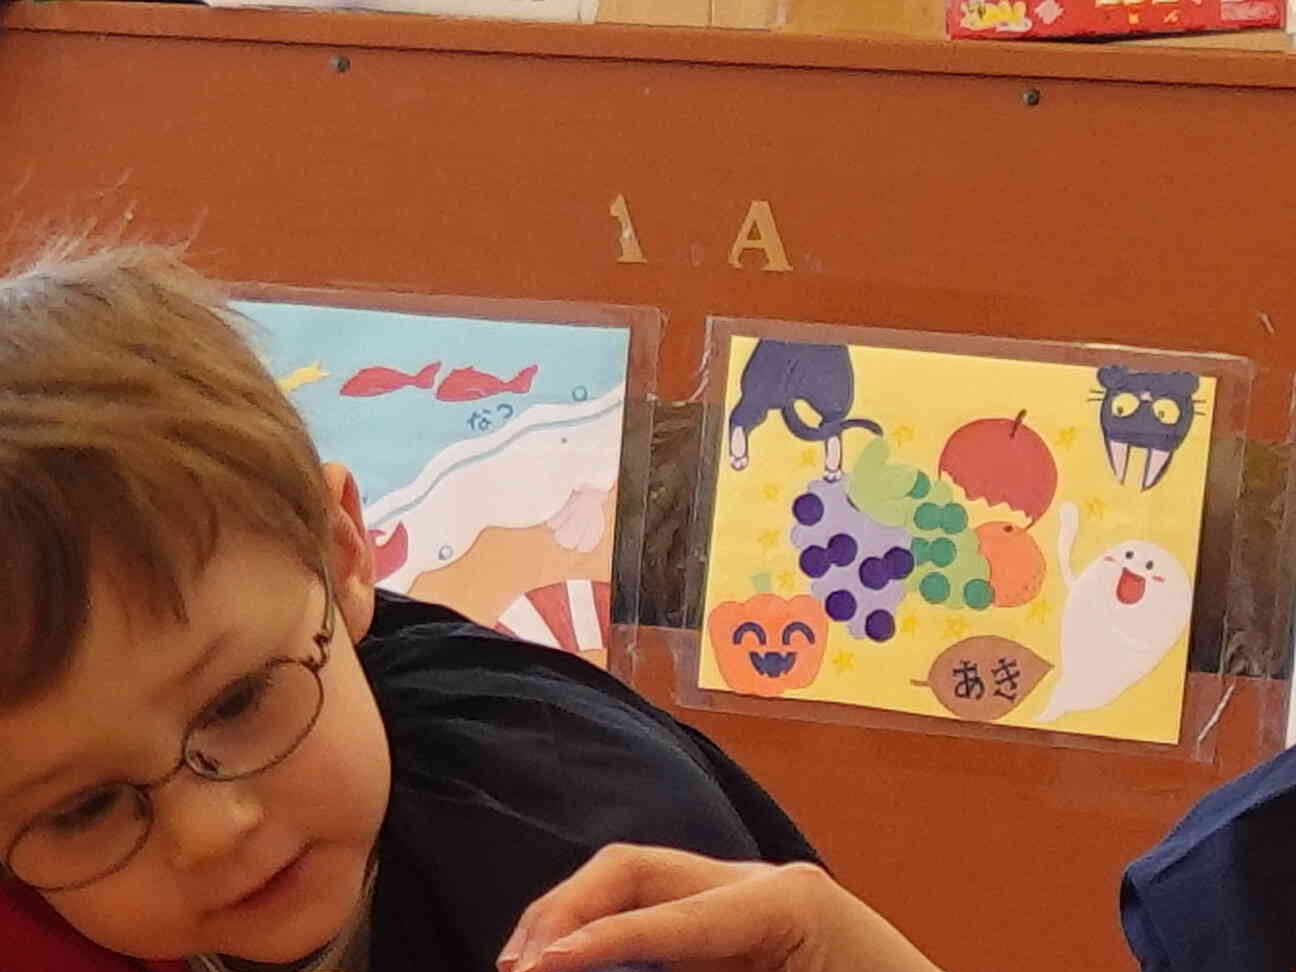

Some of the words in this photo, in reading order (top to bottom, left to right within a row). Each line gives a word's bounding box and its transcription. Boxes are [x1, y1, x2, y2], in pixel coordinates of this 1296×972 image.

[609, 193, 648, 263] 1
[727, 199, 794, 272] A
[466, 403, 514, 431] なつ
[952, 658, 1021, 703] あき
